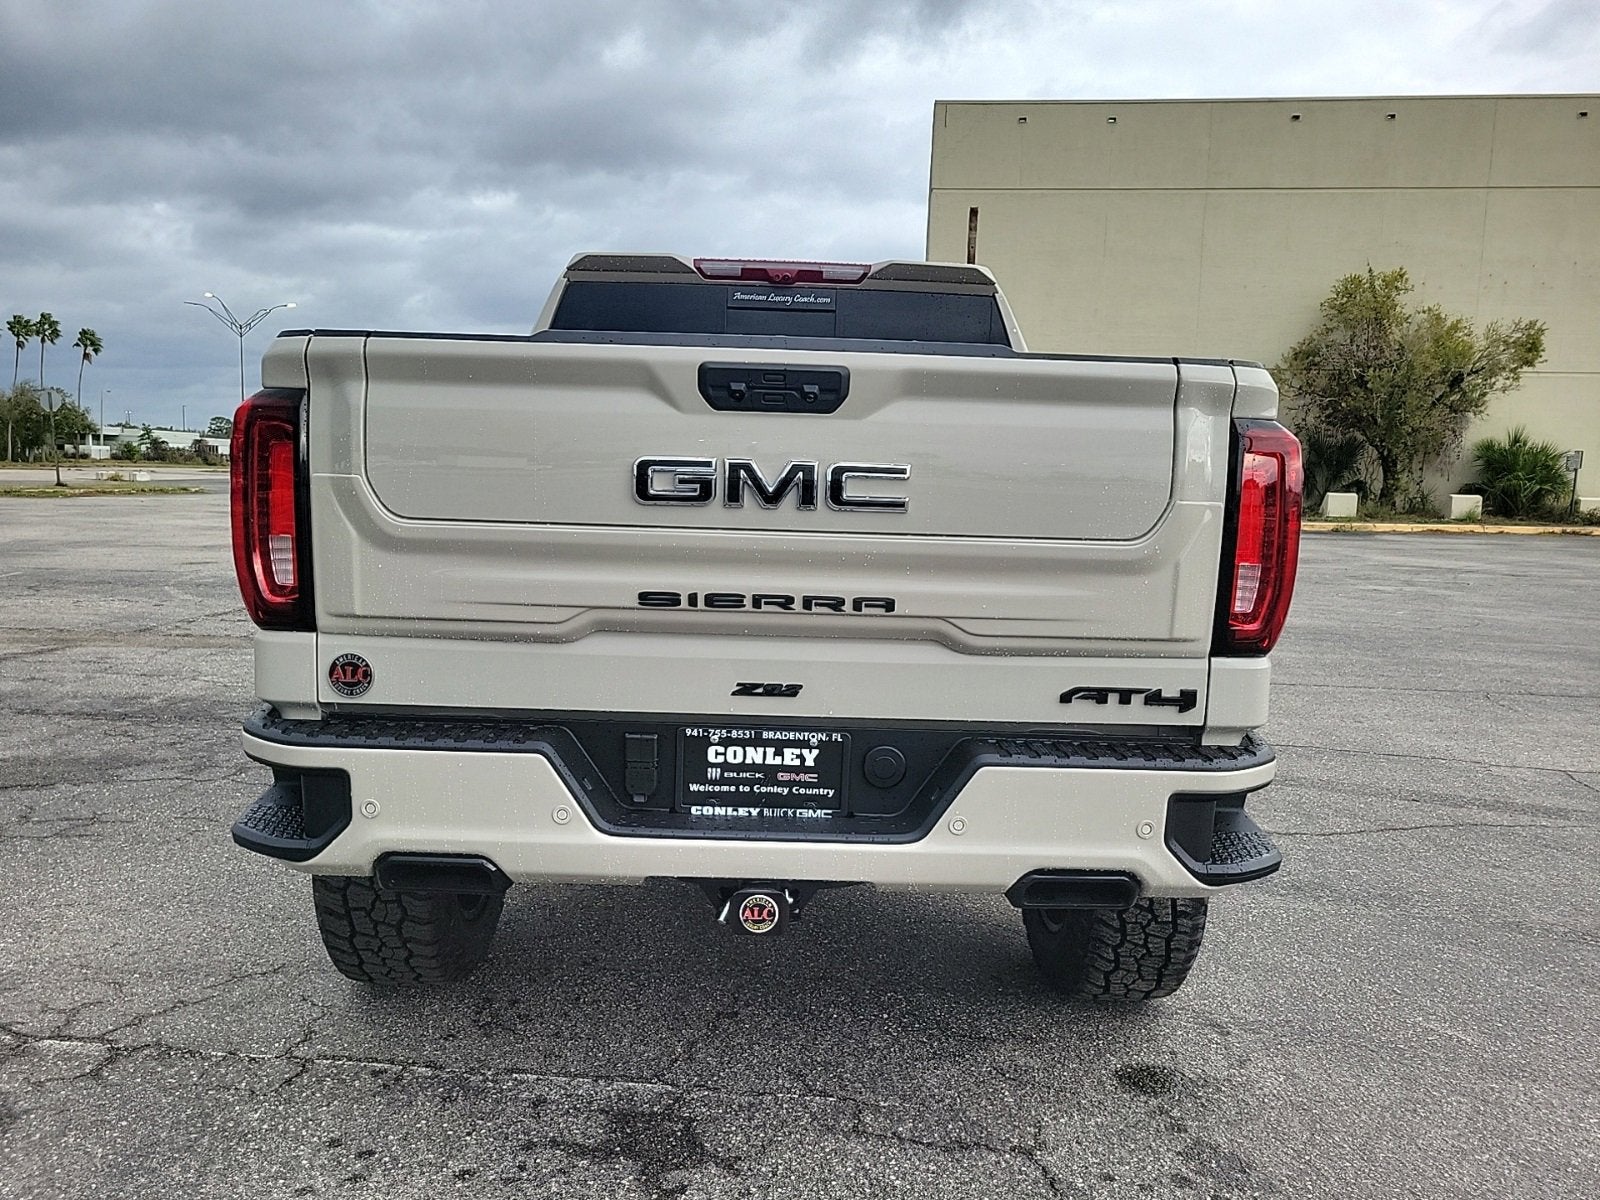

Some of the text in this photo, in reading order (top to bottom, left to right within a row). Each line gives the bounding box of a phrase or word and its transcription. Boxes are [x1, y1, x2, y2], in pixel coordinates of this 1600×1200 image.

[733, 292, 831, 306] American Luxury Coach.com
[632, 455, 912, 513] GMC
[637, 591, 896, 613] SIERRA
[330, 665, 371, 683] ALC
[1059, 686, 1198, 713] AT4
[685, 728, 843, 742] 941-755-8531 BRADENTON, FL
[707, 745, 820, 767] CONLEY
[723, 771, 765, 779] BUICK
[777, 772, 819, 782] GMC
[689, 783, 835, 798] Welcome to Conley Country
[690, 805, 833, 819] CONLEY BUICK GMC
[742, 907, 774, 920] ALC
